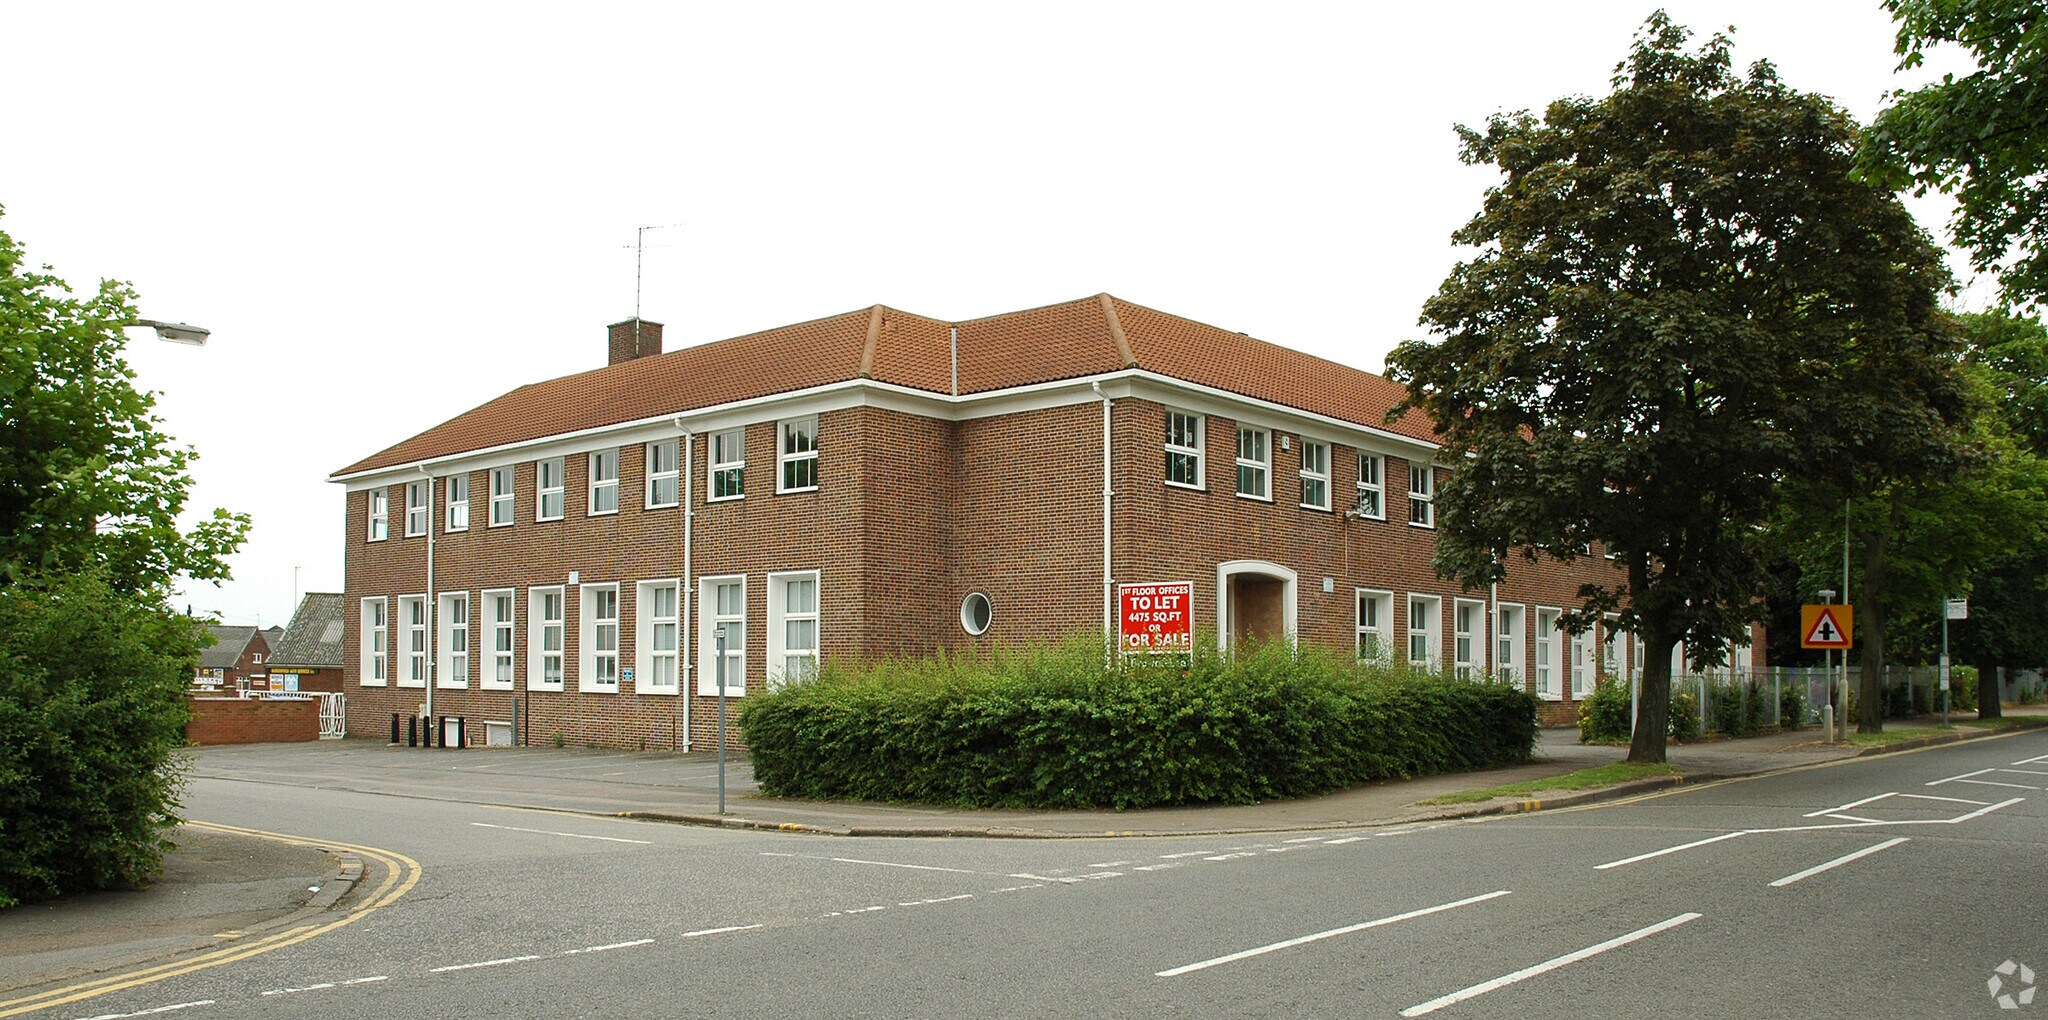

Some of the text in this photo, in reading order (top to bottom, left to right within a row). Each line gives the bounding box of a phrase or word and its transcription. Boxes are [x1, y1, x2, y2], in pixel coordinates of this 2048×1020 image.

[1132, 587, 1156, 596] FLOOR
[1158, 586, 1188, 594] OFFICES
[1130, 596, 1180, 610] TO LET
[1128, 612, 1182, 623] 4475 SQ.FT
[1148, 624, 1161, 632] OR
[1122, 633, 1189, 646] FOR SALE
